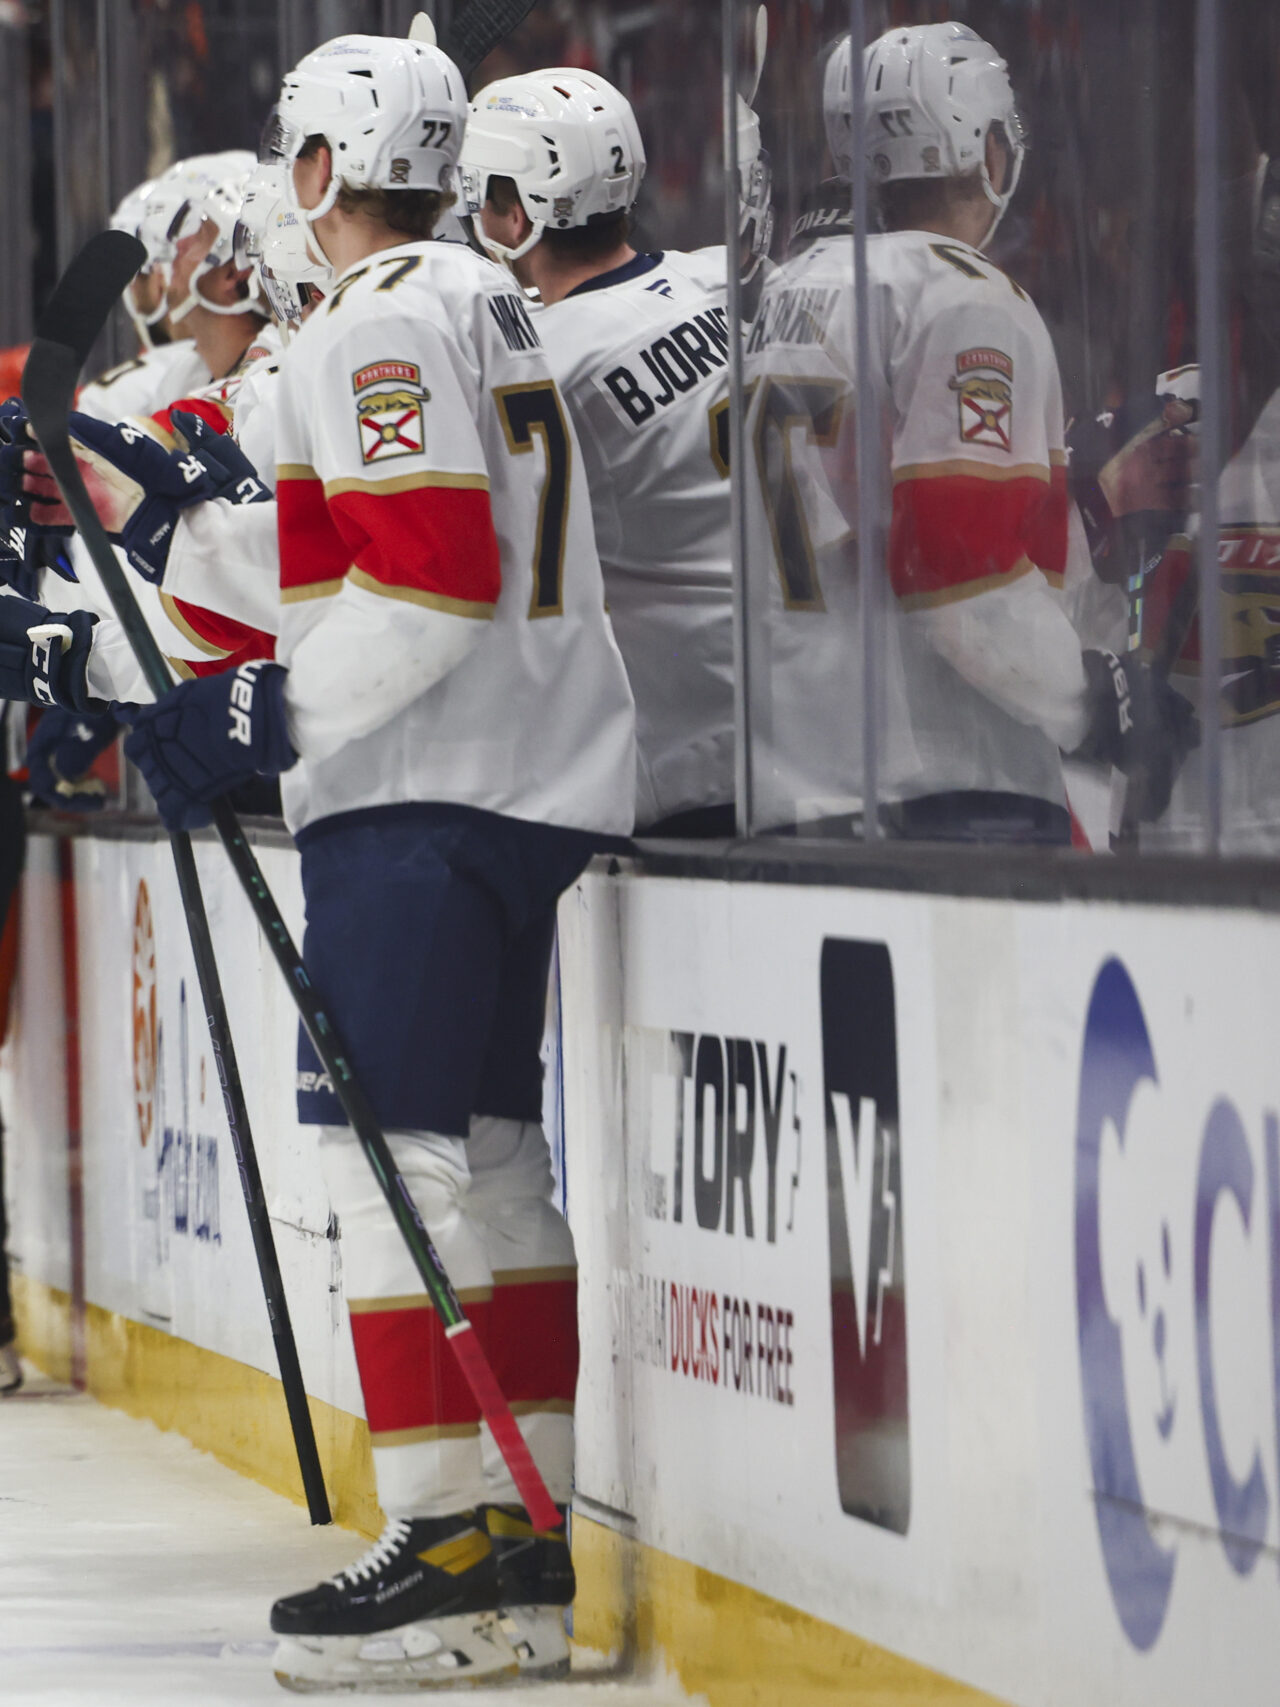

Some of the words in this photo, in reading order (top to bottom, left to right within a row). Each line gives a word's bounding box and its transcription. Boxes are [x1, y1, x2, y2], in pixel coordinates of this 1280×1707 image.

[421, 120, 452, 148] 77
[610, 146, 627, 174] 2
[671, 1281, 719, 1387] DUCKS
[723, 1294, 754, 1396] FOR
[756, 1302, 794, 1407] FREE
